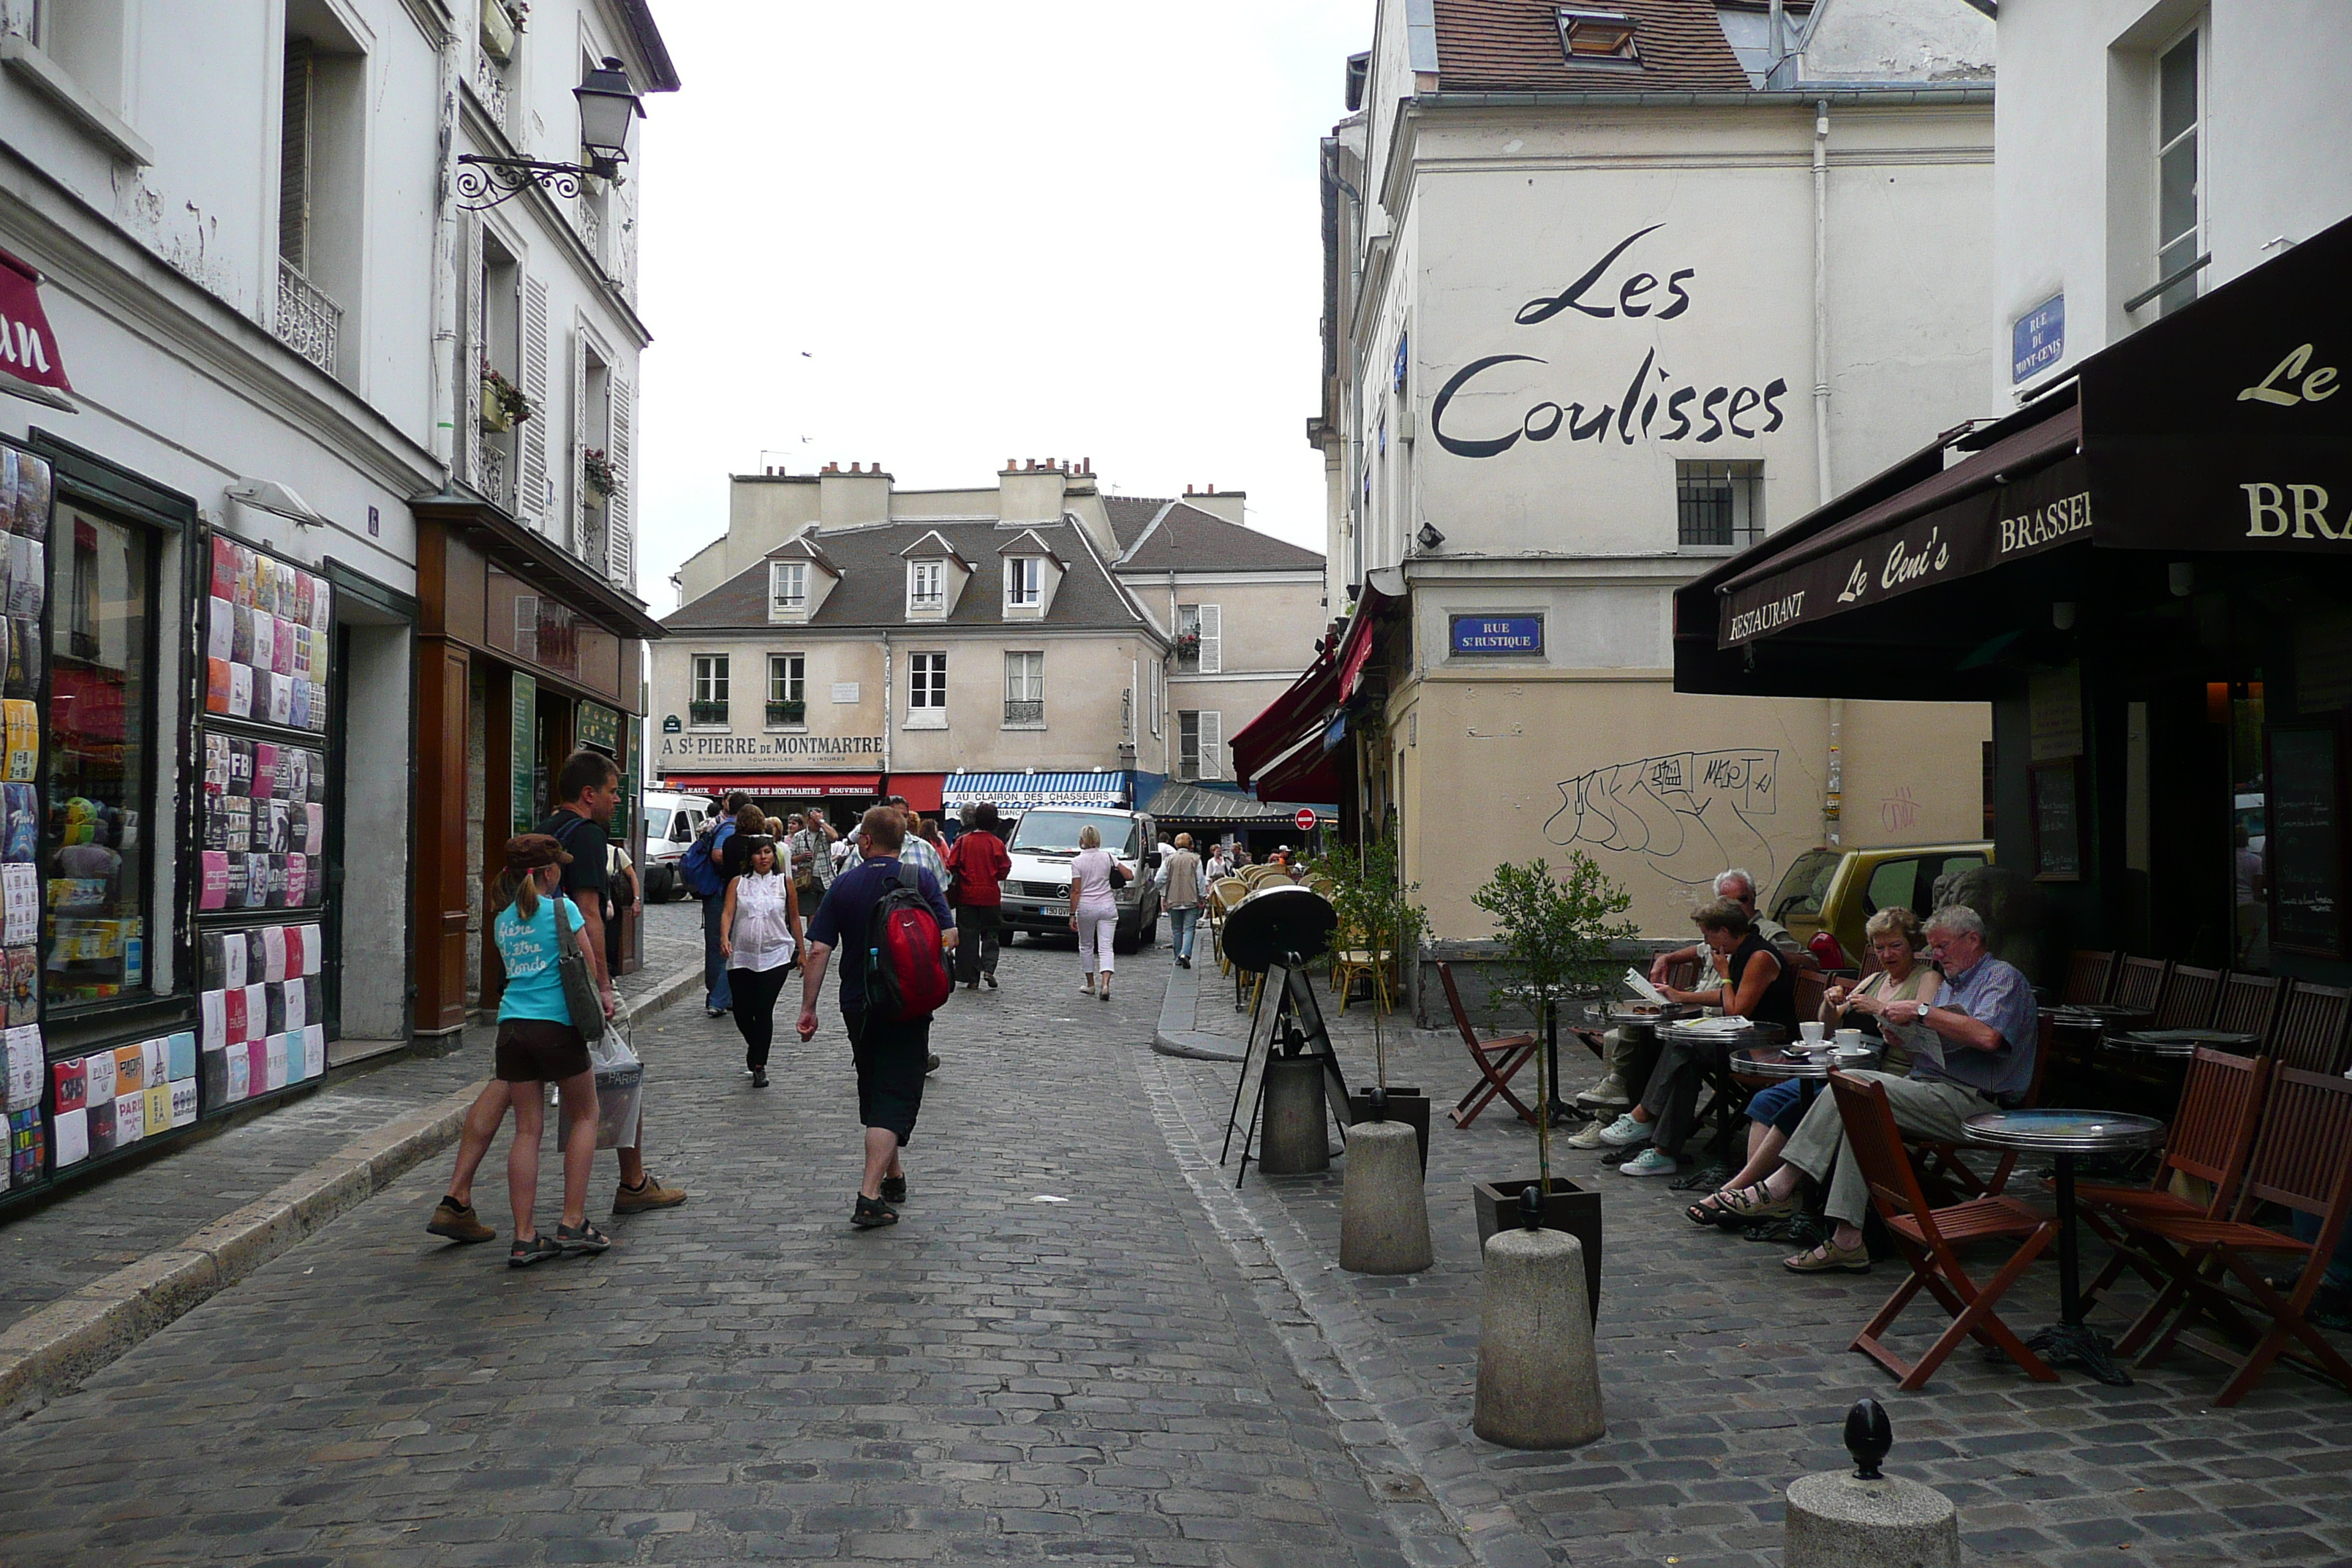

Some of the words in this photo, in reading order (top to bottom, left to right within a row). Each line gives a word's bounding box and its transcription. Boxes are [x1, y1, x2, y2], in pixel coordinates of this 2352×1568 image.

[1515, 222, 1695, 325] Les
[2030, 312, 2046, 333] RUE
[2032, 331, 2044, 349] DU
[2016, 338, 2061, 374] MONT-CENIS
[2236, 343, 2340, 406] Le
[1431, 345, 1787, 459] Coulisses
[1729, 590, 1806, 641] RESTAURANT
[1837, 558, 1867, 603] Le
[1882, 526, 1949, 589] Ceni's
[1483, 623, 1509, 633] RUE
[1475, 636, 1531, 648] RUSTIQUE
[662, 739, 673, 754] A
[698, 738, 756, 754] PIERRE
[761, 745, 772, 753] DE
[775, 736, 883, 754] MONTMARTRE
[231, 753, 252, 779] FBI
[1024, 793, 1043, 801] DES
[1049, 792, 1109, 801] CHASSEURS
[1046, 907, 1058, 915] 190
[499, 921, 535, 944] fière
[500, 941, 543, 957] d'être
[94, 1062, 114, 1077] PARIS
[608, 1071, 639, 1085] PARIS
[119, 1098, 143, 1117] PARIS
